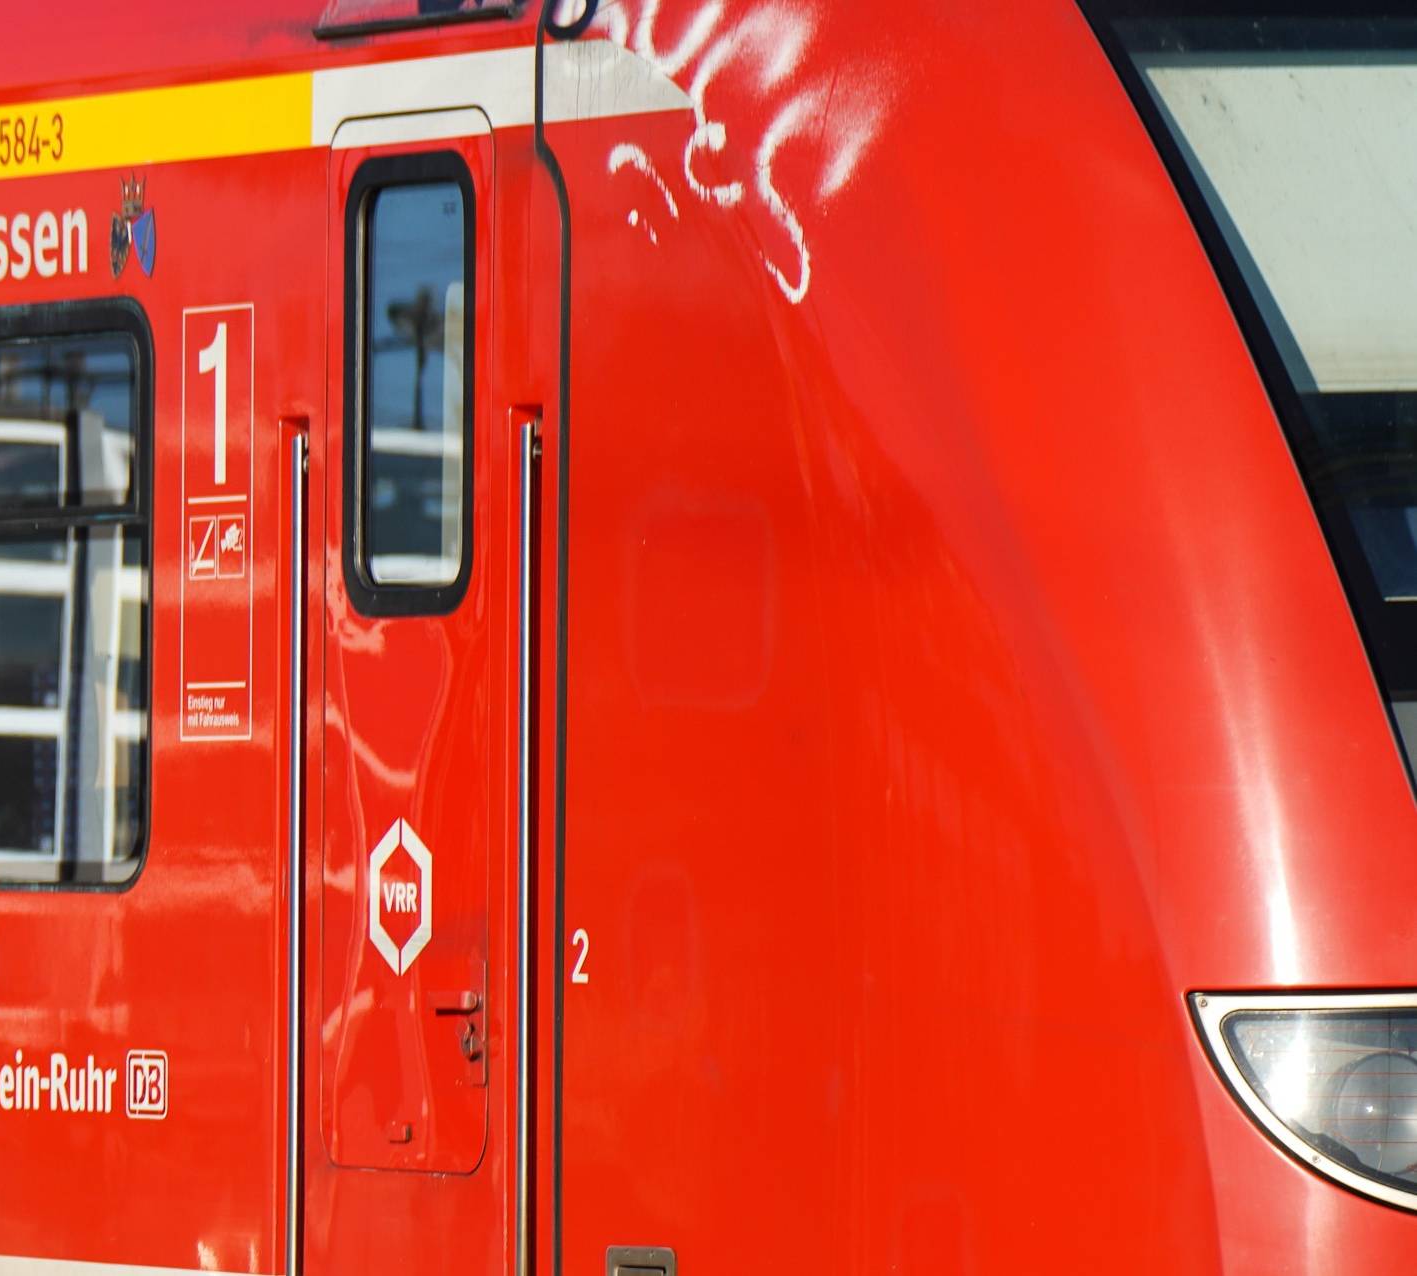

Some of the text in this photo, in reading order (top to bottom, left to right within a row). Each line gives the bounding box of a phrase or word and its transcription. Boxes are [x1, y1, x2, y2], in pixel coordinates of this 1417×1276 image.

[198, 321, 228, 486] 1
[187, 694, 225, 713] Einstieg nur
[187, 711, 240, 729] mit Fahrausweis
[383, 881, 418, 914] VRR
[571, 927, 590, 985] 2
[131, 1060, 165, 1109] DB
